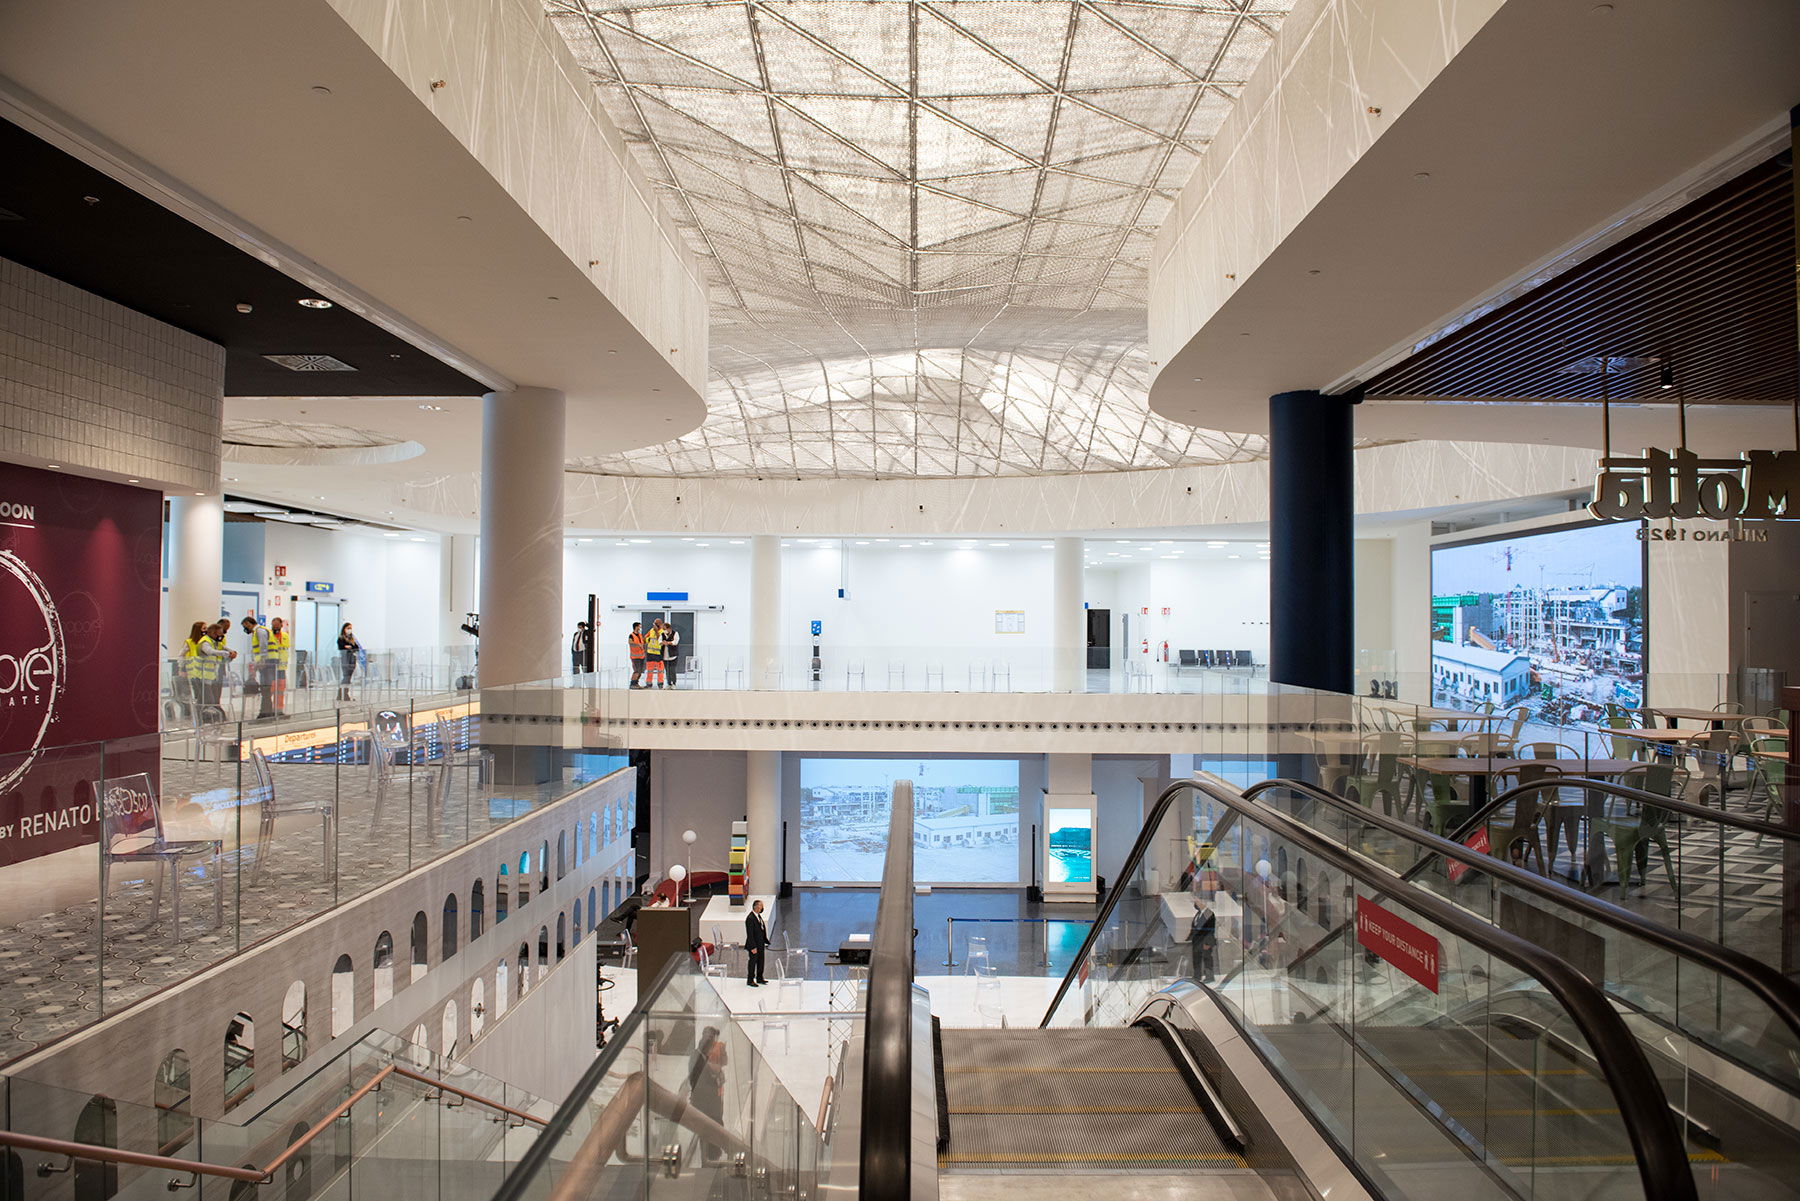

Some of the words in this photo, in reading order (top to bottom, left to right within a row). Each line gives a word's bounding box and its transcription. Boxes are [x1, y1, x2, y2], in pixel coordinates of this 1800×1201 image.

[0, 694, 40, 706] ATE
[20, 803, 91, 839] RENATO
[1369, 921, 1382, 936] KEEP
[1396, 937, 1424, 963] DISTANCE
